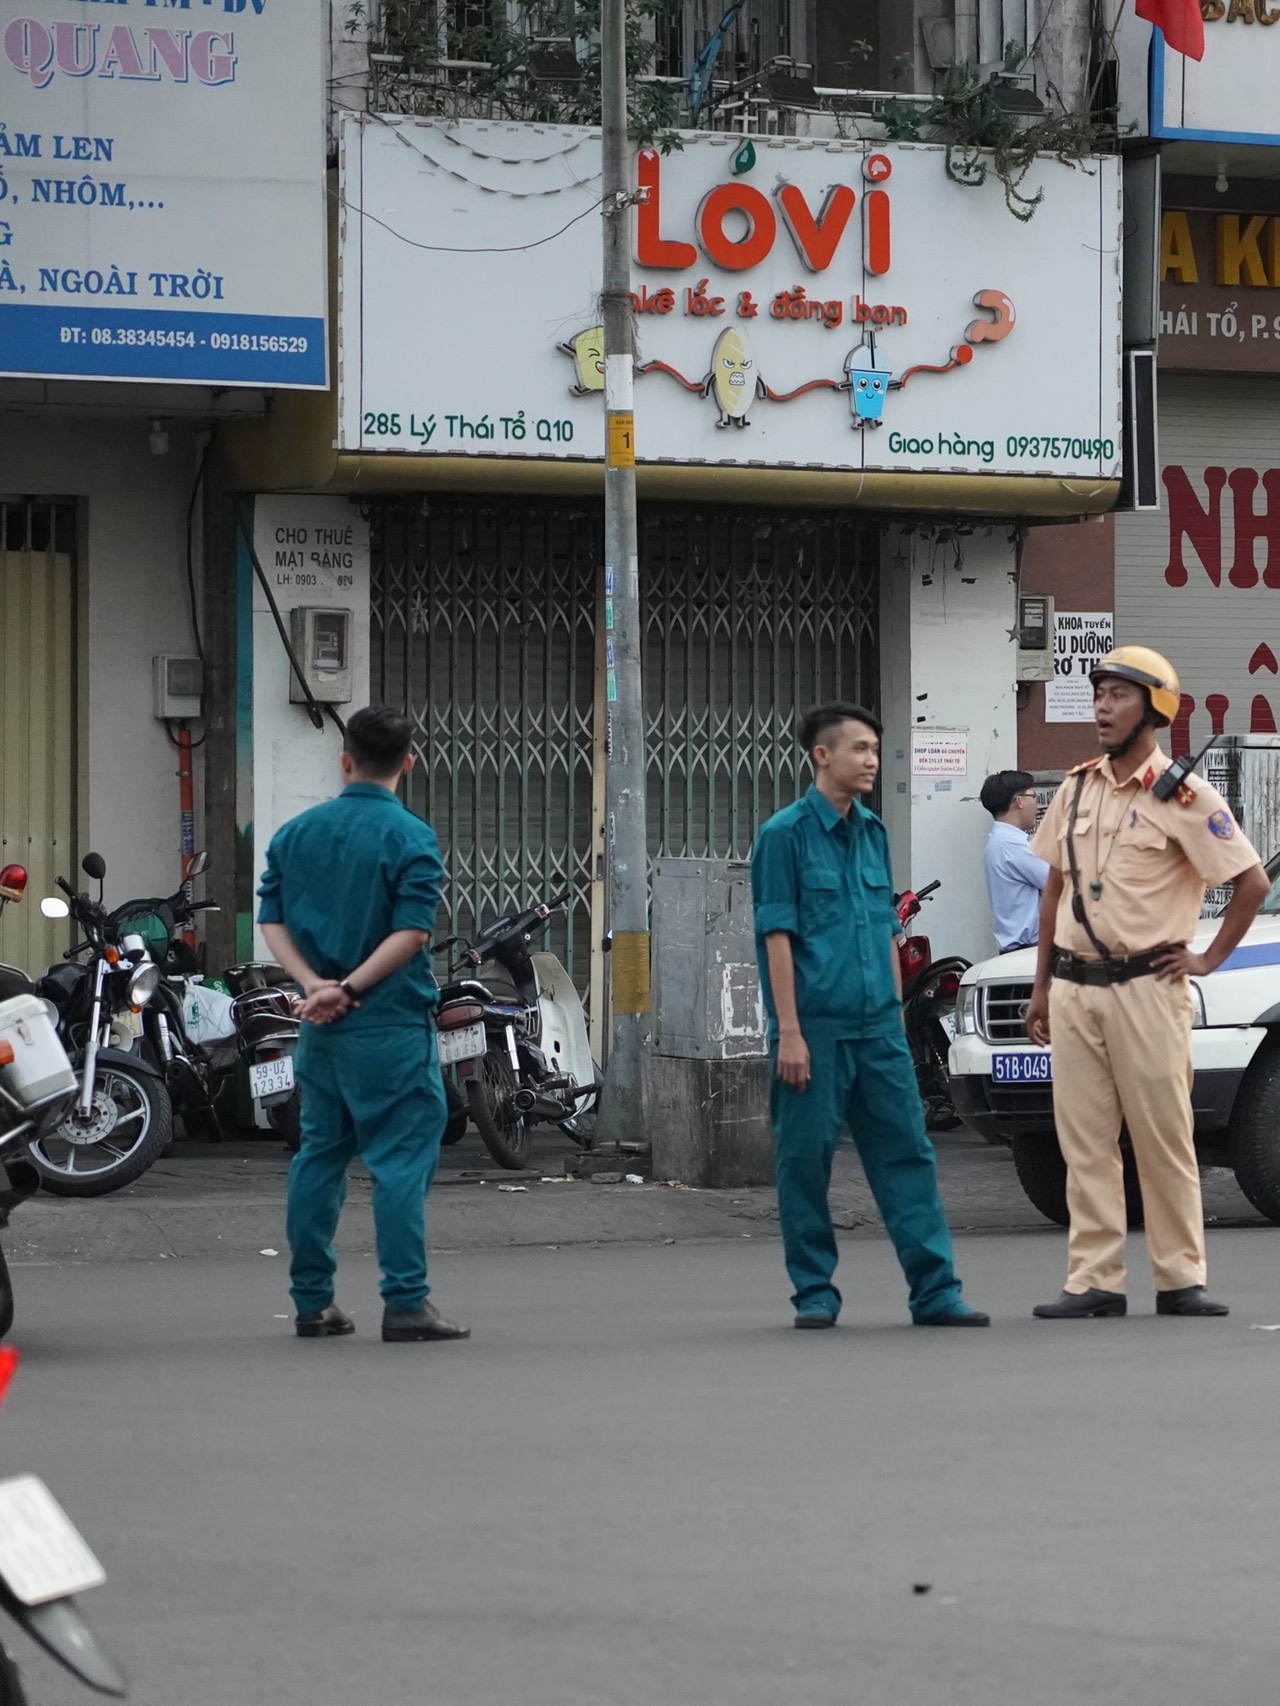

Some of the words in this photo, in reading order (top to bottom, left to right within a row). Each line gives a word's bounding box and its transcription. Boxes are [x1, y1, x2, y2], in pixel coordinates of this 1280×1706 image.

[4, 18, 238, 89] QUANG
[53, 135, 114, 161] LEN
[39, 264, 138, 296] NGOÀI
[148, 268, 225, 300] TRỜI
[738, 291, 758, 318] &
[1159, 304, 1198, 336] HÁI
[60, 326, 87, 345] ĐT:
[91, 327, 196, 348] 08.38345454
[210, 332, 308, 353] 0918156529
[363, 412, 401, 436] 285
[410, 413, 436, 445] Lý
[445, 414, 495, 440] Thái
[499, 410, 526, 441] Tổ
[536, 419, 574, 443] Q10
[888, 431, 934, 454] Giao
[938, 431, 995, 463] hàng
[1006, 435, 1115, 461] 0937570490
[275, 527, 308, 544] CHO
[315, 525, 354, 546] THUÊ
[1058, 616, 1083, 630] KHOA
